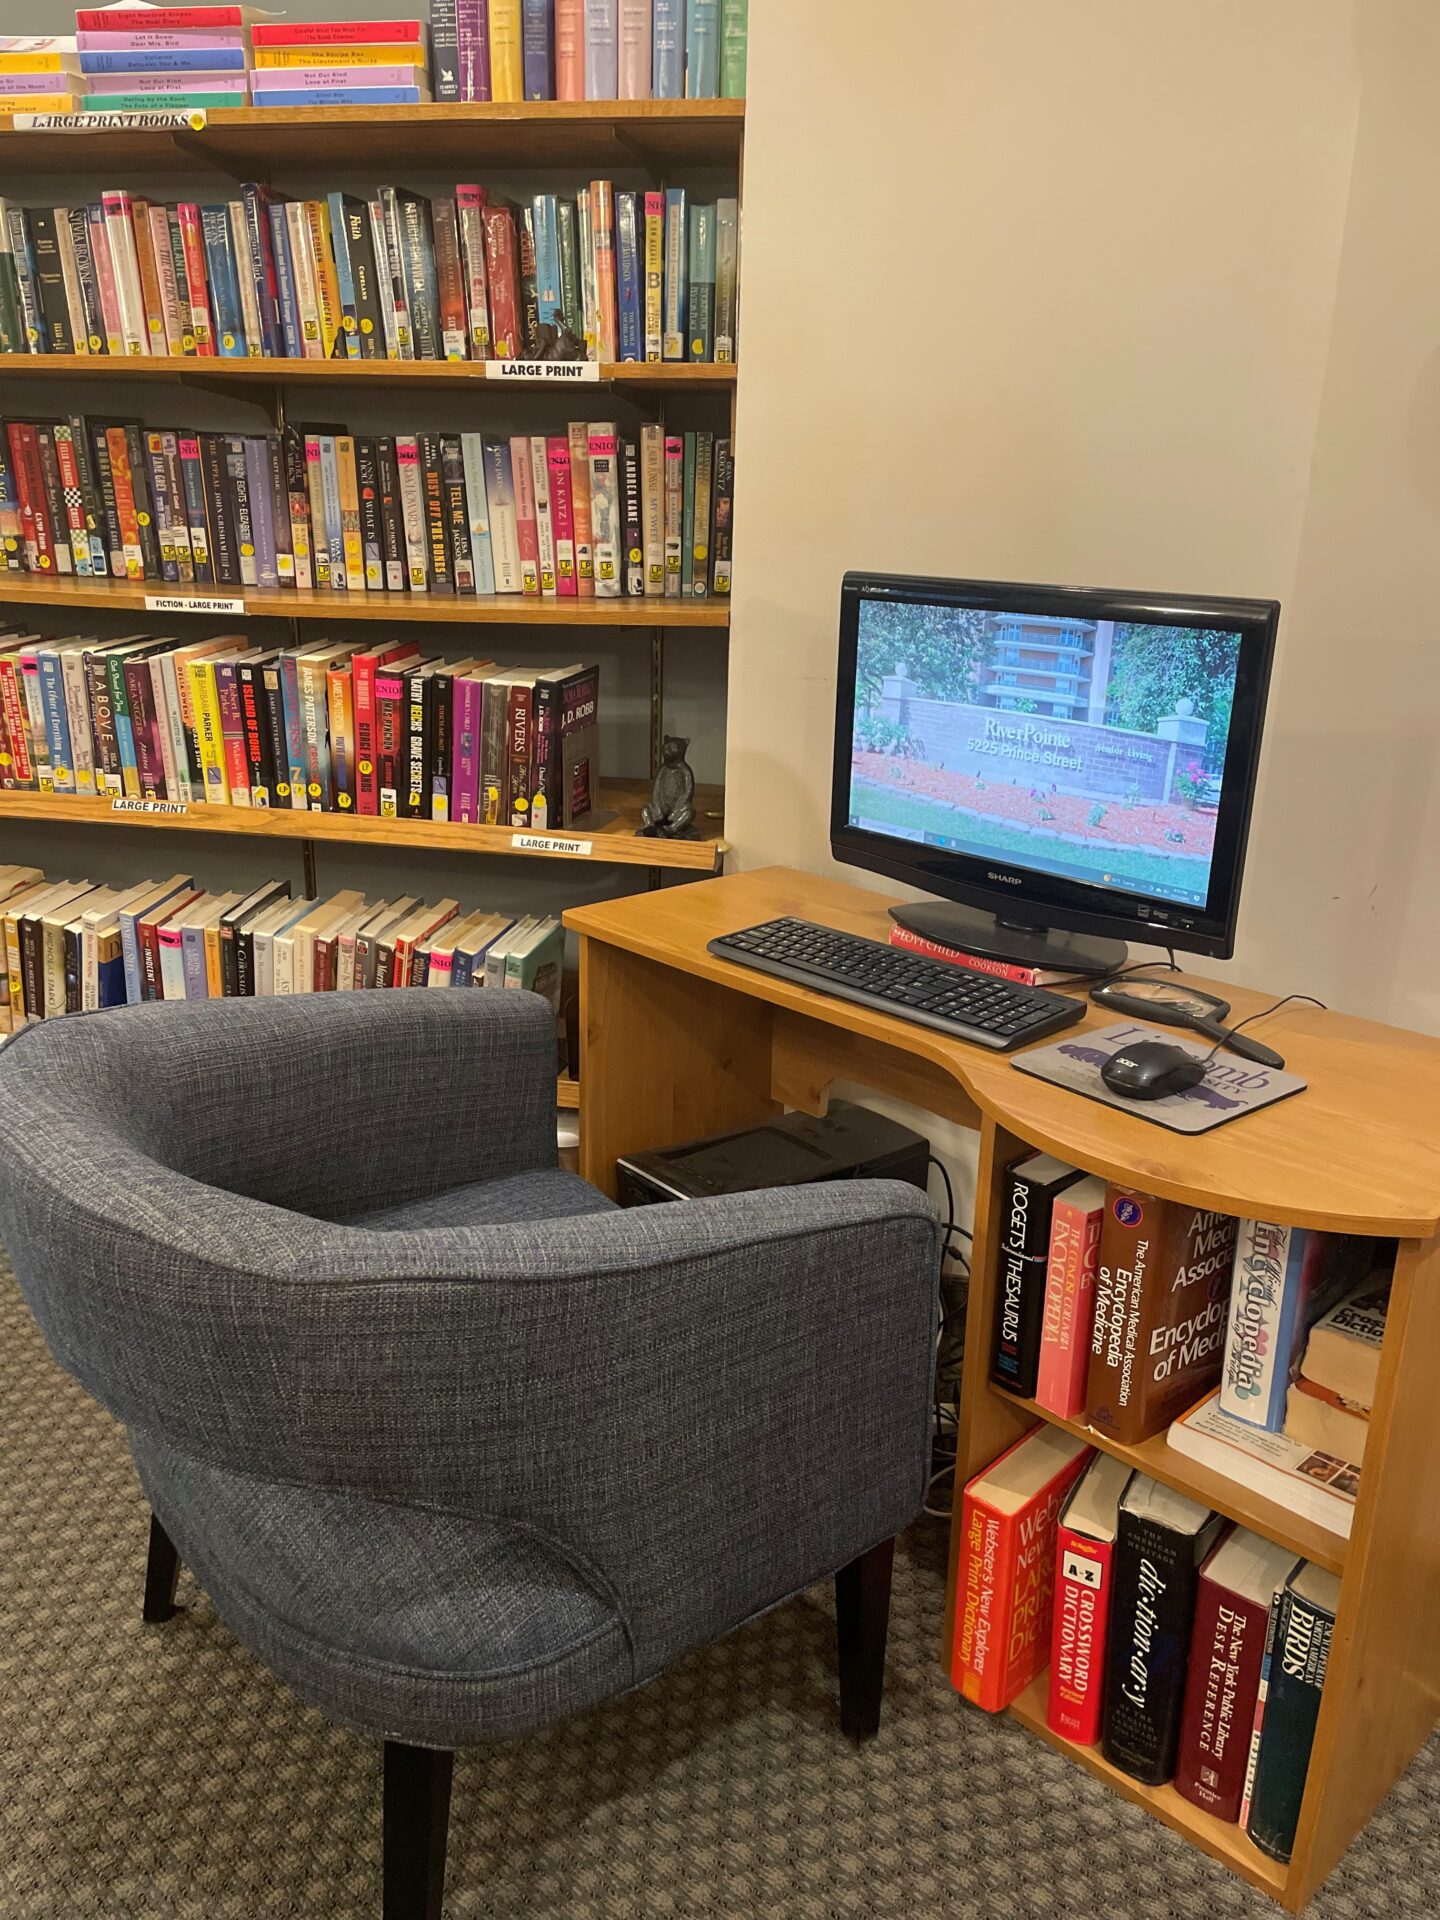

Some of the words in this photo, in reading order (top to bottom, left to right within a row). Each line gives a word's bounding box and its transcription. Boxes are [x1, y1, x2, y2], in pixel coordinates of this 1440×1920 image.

[31, 115, 85, 129] LARGE
[86, 115, 141, 128] PRINT
[141, 114, 189, 128] BOOKS
[70, 212, 84, 242] SYLVIA
[308, 203, 318, 233] HARLAN
[350, 215, 362, 240] Faith
[404, 203, 418, 242] PATRICIA
[160, 250, 170, 267] THE
[171, 227, 184, 278] VIGILANTE
[312, 237, 323, 262] COBEN
[521, 231, 530, 276] COULTER
[74, 244, 92, 284] BROWNE
[318, 270, 326, 284] THE
[389, 249, 401, 279] COOK
[410, 246, 425, 293] CORNWELL
[162, 269, 175, 303] GOLDEN
[321, 288, 333, 326] INNOCENT
[501, 365, 543, 375] LARGE
[546, 366, 583, 377] PRINT
[59, 443, 70, 460] FELIX
[99, 452, 109, 476] DARK
[153, 456, 164, 473] ZANE
[423, 438, 431, 467] HOWARTH
[493, 445, 501, 467] JOHN
[647, 446, 662, 466] LAURA
[63, 461, 74, 486] FRANCIS
[211, 458, 220, 489] APPEAL
[235, 458, 244, 478] CRAZY
[495, 469, 504, 489] JAKES
[626, 461, 636, 496] ANDREA
[717, 450, 726, 491] KOONTZ
[103, 482, 114, 507] MOON
[156, 474, 167, 492] GREY
[236, 480, 246, 502] EIGHTS
[426, 472, 439, 496] DUST
[450, 486, 462, 507] TELL
[215, 492, 223, 513] JOHN
[365, 501, 373, 529] WHAT
[406, 486, 418, 526] HOWARD
[430, 501, 441, 518] OFF
[627, 500, 638, 522] KANE
[650, 498, 658, 512] MY
[35, 513, 43, 531] CAMP
[71, 508, 80, 528] CRISIS
[239, 508, 250, 540] ELIZABETH
[431, 521, 443, 539] THE
[453, 511, 464, 525] ME
[650, 515, 658, 543] SWEET
[217, 515, 226, 551] GRISHAM
[452, 529, 462, 561] JACKSON
[433, 543, 446, 572] BONES
[156, 600, 183, 608] FICTION
[189, 601, 211, 609] LARGE
[129, 672, 139, 698] CARLA
[177, 667, 185, 689] DELIA
[181, 692, 189, 719] OWENS
[303, 667, 313, 694] JAMES
[410, 679, 423, 703] KATHY
[115, 691, 123, 700] for
[116, 701, 124, 712] Joy
[198, 680, 208, 713] BARBARA
[220, 689, 229, 715] Parker
[229, 683, 237, 710] Robert
[243, 685, 256, 718] ISLAND
[46, 678, 55, 688] The
[52, 719, 63, 750] Everything
[96, 682, 113, 741] ABOVE
[133, 700, 144, 736] NEGGERS
[246, 719, 257, 731] OF
[268, 693, 276, 715] JAMES
[272, 716, 281, 756] PATTERSON
[305, 696, 317, 744] PATTERSON
[410, 705, 423, 731] REICHS
[575, 702, 594, 720] ROBB
[202, 713, 213, 742] PARKER
[358, 723, 370, 751] GEORGE
[383, 719, 393, 750] PYNCHON
[515, 708, 525, 752] RIVERS
[984, 716, 1071, 749] RiverPointe
[249, 733, 262, 762] BONES
[410, 736, 423, 760] GRAVE
[966, 738, 997, 755] 5225
[1000, 744, 1040, 764] Prince
[1043, 751, 1083, 771] Street
[1095, 742, 1124, 756] Senior
[1127, 747, 1154, 762] Living
[410, 761, 423, 793] SECRETS
[113, 801, 149, 811] LARGE
[153, 802, 186, 813] PRINT
[520, 839, 550, 849] LARGE
[552, 841, 581, 852] PRINT
[987, 872, 1022, 885] SHARP
[47, 931, 55, 975] NICHOLAS
[901, 931, 926, 947] LOVE
[926, 943, 960, 958] CHILD
[144, 948, 155, 982] INNOCENT
[237, 950, 246, 995] CHRYSALIS
[969, 958, 1009, 977] COOKSON
[47, 978, 55, 1006] SPARKS
[1116, 1057, 1138, 1068] acer
[1009, 1181, 1029, 1251] ROGET'S
[1071, 1228, 1080, 1249] THE
[1136, 1240, 1148, 1258] The
[1044, 1219, 1070, 1344] ENCYCLOPEDIA
[1099, 1267, 1112, 1287] of
[1130, 1260, 1146, 1309] American
[1003, 1257, 1023, 1343] THESAURUS
[1236, 1220, 1272, 1395] Encyclopedia
[1092, 1285, 1111, 1354] Medicine
[1107, 1268, 1132, 1367] Encyclopedia
[1126, 1310, 1140, 1350] Medical
[1119, 1351, 1135, 1407] Association
[968, 1509, 986, 1551] Large
[1127, 1532, 1177, 1556] AMERICAN
[1143, 1529, 1162, 1540] THE
[983, 1519, 1000, 1583] Webster's
[1127, 1541, 1174, 1565] HERITAGE
[967, 1554, 982, 1590] Print
[979, 1585, 994, 1616] New
[959, 1591, 980, 1666] Dictionary
[1058, 1585, 1079, 1683] DICTIONARY
[1214, 1605, 1234, 1653] DESK
[1232, 1614, 1247, 1636] The
[973, 1618, 990, 1675] Explorer
[1074, 1589, 1095, 1692] CROSSWORD
[1228, 1636, 1243, 1662] New
[1282, 1603, 1315, 1680] BIRDS
[1225, 1663, 1239, 1688] York
[1199, 1656, 1226, 1751] REFERENCE
[1220, 1687, 1236, 1721] Public
[1212, 1720, 1230, 1760] Library
[1194, 1780, 1222, 1801] Prentice
[1198, 1790, 1214, 1804] Hall
